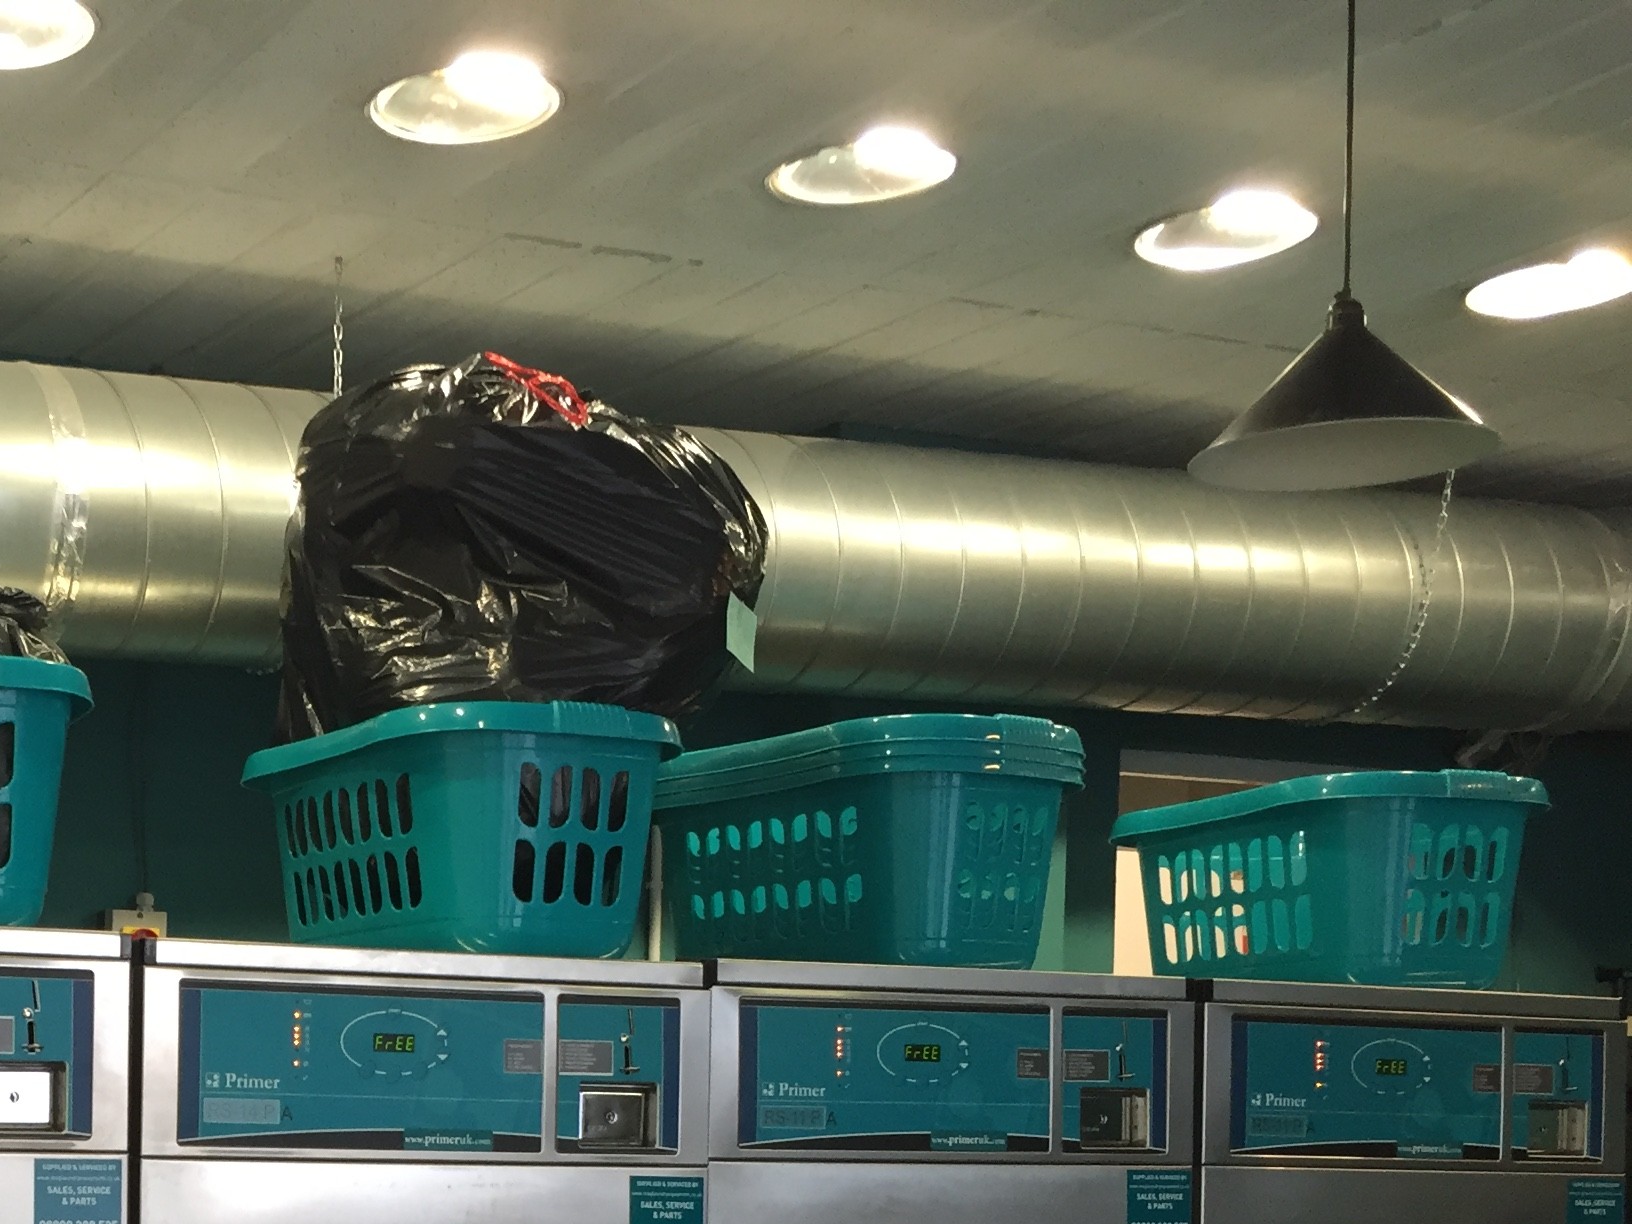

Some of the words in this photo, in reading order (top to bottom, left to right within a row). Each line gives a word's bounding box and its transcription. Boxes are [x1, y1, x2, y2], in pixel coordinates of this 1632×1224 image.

[225, 1072, 280, 1089] Primer
[779, 1082, 826, 1097] Primer
[1265, 1093, 1306, 1107] Primer
[281, 1105, 293, 1120] A
[826, 1111, 837, 1125] A
[47, 1186, 76, 1195] SALES,
[77, 1186, 111, 1195] SERVICE
[61, 1197, 68, 1205] &
[70, 1197, 97, 1205] PARTS
[659, 1211, 683, 1220] PARTS
